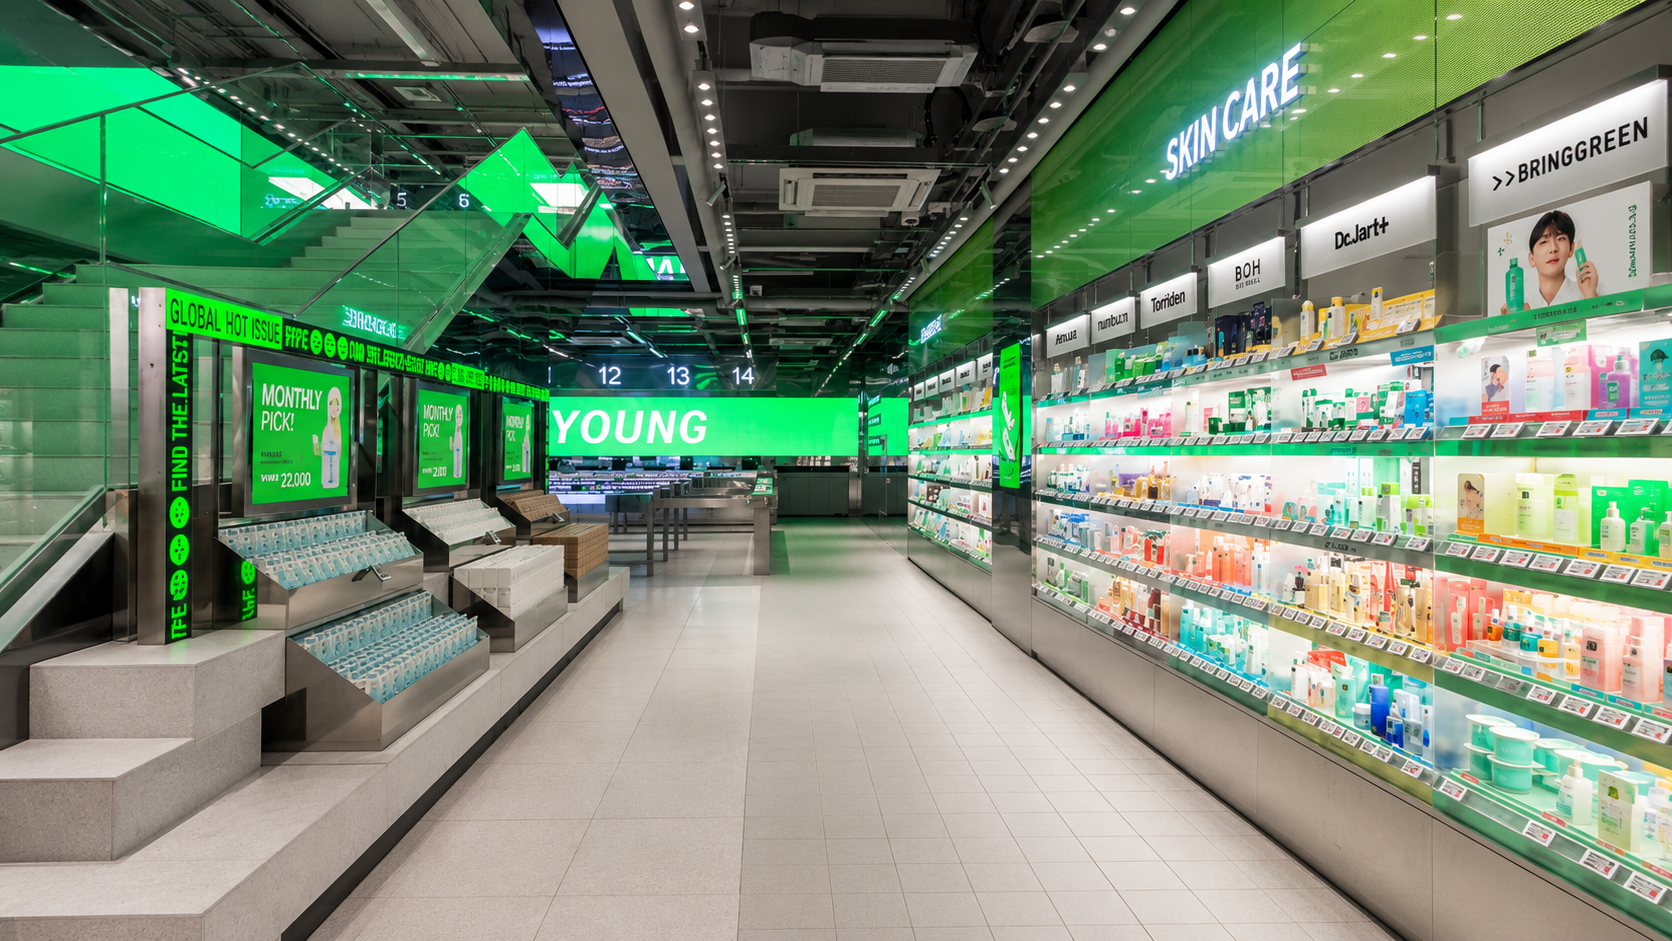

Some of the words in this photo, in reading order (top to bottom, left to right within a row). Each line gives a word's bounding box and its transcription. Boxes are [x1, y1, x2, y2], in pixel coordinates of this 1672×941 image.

[1165, 105, 1218, 181] SKIN
[1222, 41, 1302, 140] CARE
[1518, 116, 1648, 183] BRINGGREEN
[396, 191, 407, 208] 5
[458, 193, 470, 208] 6
[1235, 258, 1261, 282] BOH
[170, 298, 221, 332] GLOBAL
[226, 311, 249, 338] HOT
[251, 317, 280, 344] ISSUE
[598, 366, 622, 385] 12
[667, 366, 690, 385] 13
[732, 366, 755, 385] 14
[261, 383, 323, 411] MONTHLY
[261, 410, 295, 432] PICK!
[551, 409, 708, 445] YOUNG
[171, 446, 188, 492] FIND
